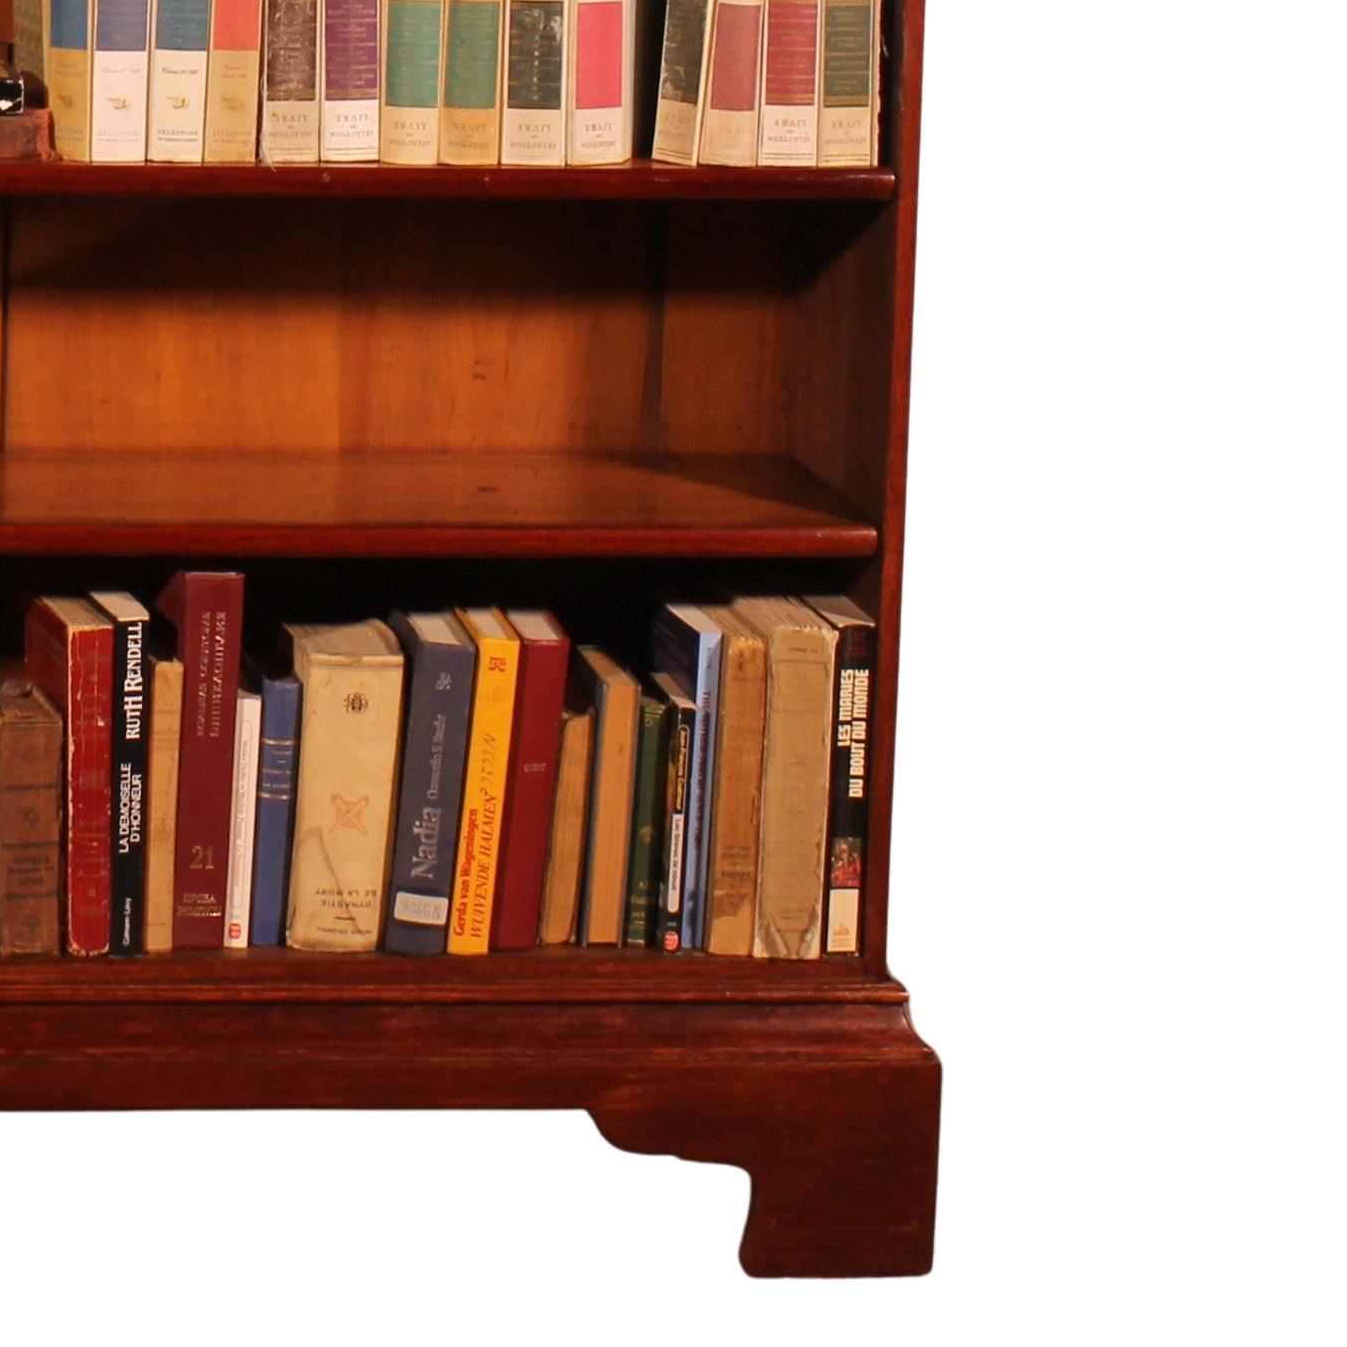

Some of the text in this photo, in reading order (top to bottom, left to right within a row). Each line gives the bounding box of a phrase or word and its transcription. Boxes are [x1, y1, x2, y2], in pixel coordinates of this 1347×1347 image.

[275, 113, 307, 121] LIVRE
[335, 113, 368, 122] LIVRE
[393, 121, 426, 130] LIVRE
[516, 123, 551, 132] LIVRE
[584, 122, 612, 132] LIVRE
[774, 118, 806, 127] LIVRE
[124, 622, 143, 738] RUTH RENDELL
[837, 725, 851, 747] LES
[848, 669, 869, 798] DU BOUT DU MONDE
[119, 762, 132, 853] LA DEMOISELLE
[131, 774, 142, 842] D'HONNEUR
[411, 807, 441, 880] Nadia
[190, 845, 214, 869] 21
[470, 860, 488, 938] WUIVENDE
[480, 793, 497, 857] HALMEN
[453, 808, 478, 936] Gerda van Wageningen
[316, 888, 343, 896] MORT
[321, 900, 371, 908] DYNASTIE
